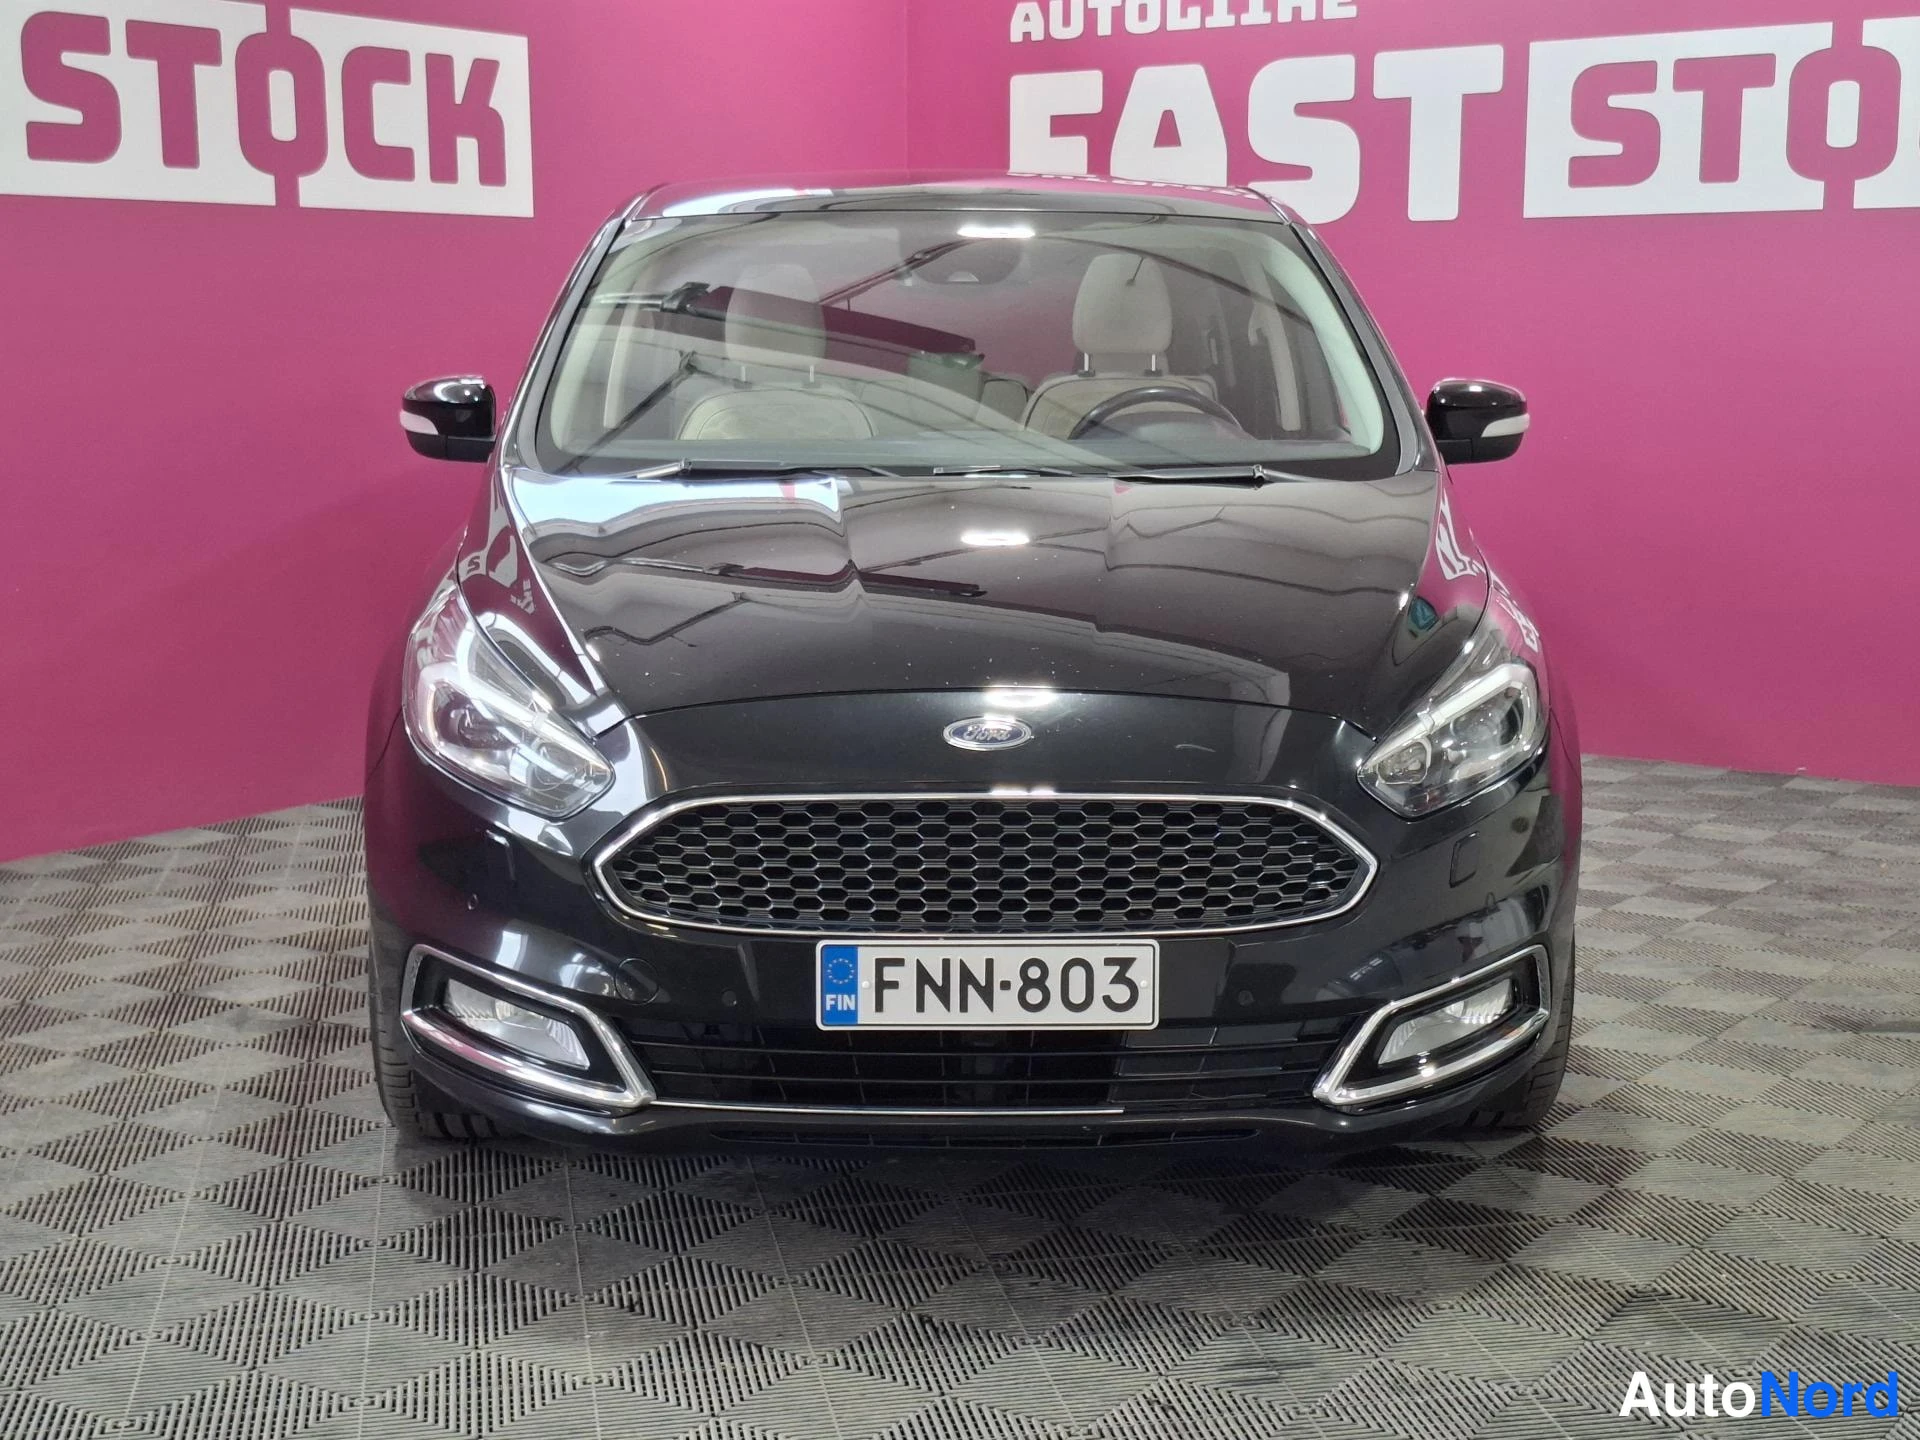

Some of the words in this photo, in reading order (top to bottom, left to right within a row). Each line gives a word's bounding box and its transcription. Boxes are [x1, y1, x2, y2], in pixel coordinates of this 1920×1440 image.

[20, 10, 508, 188] STOCK
[1567, 45, 1920, 189] STO
[825, 994, 856, 1011] FIN
[874, 957, 1140, 1013] FNN-803
